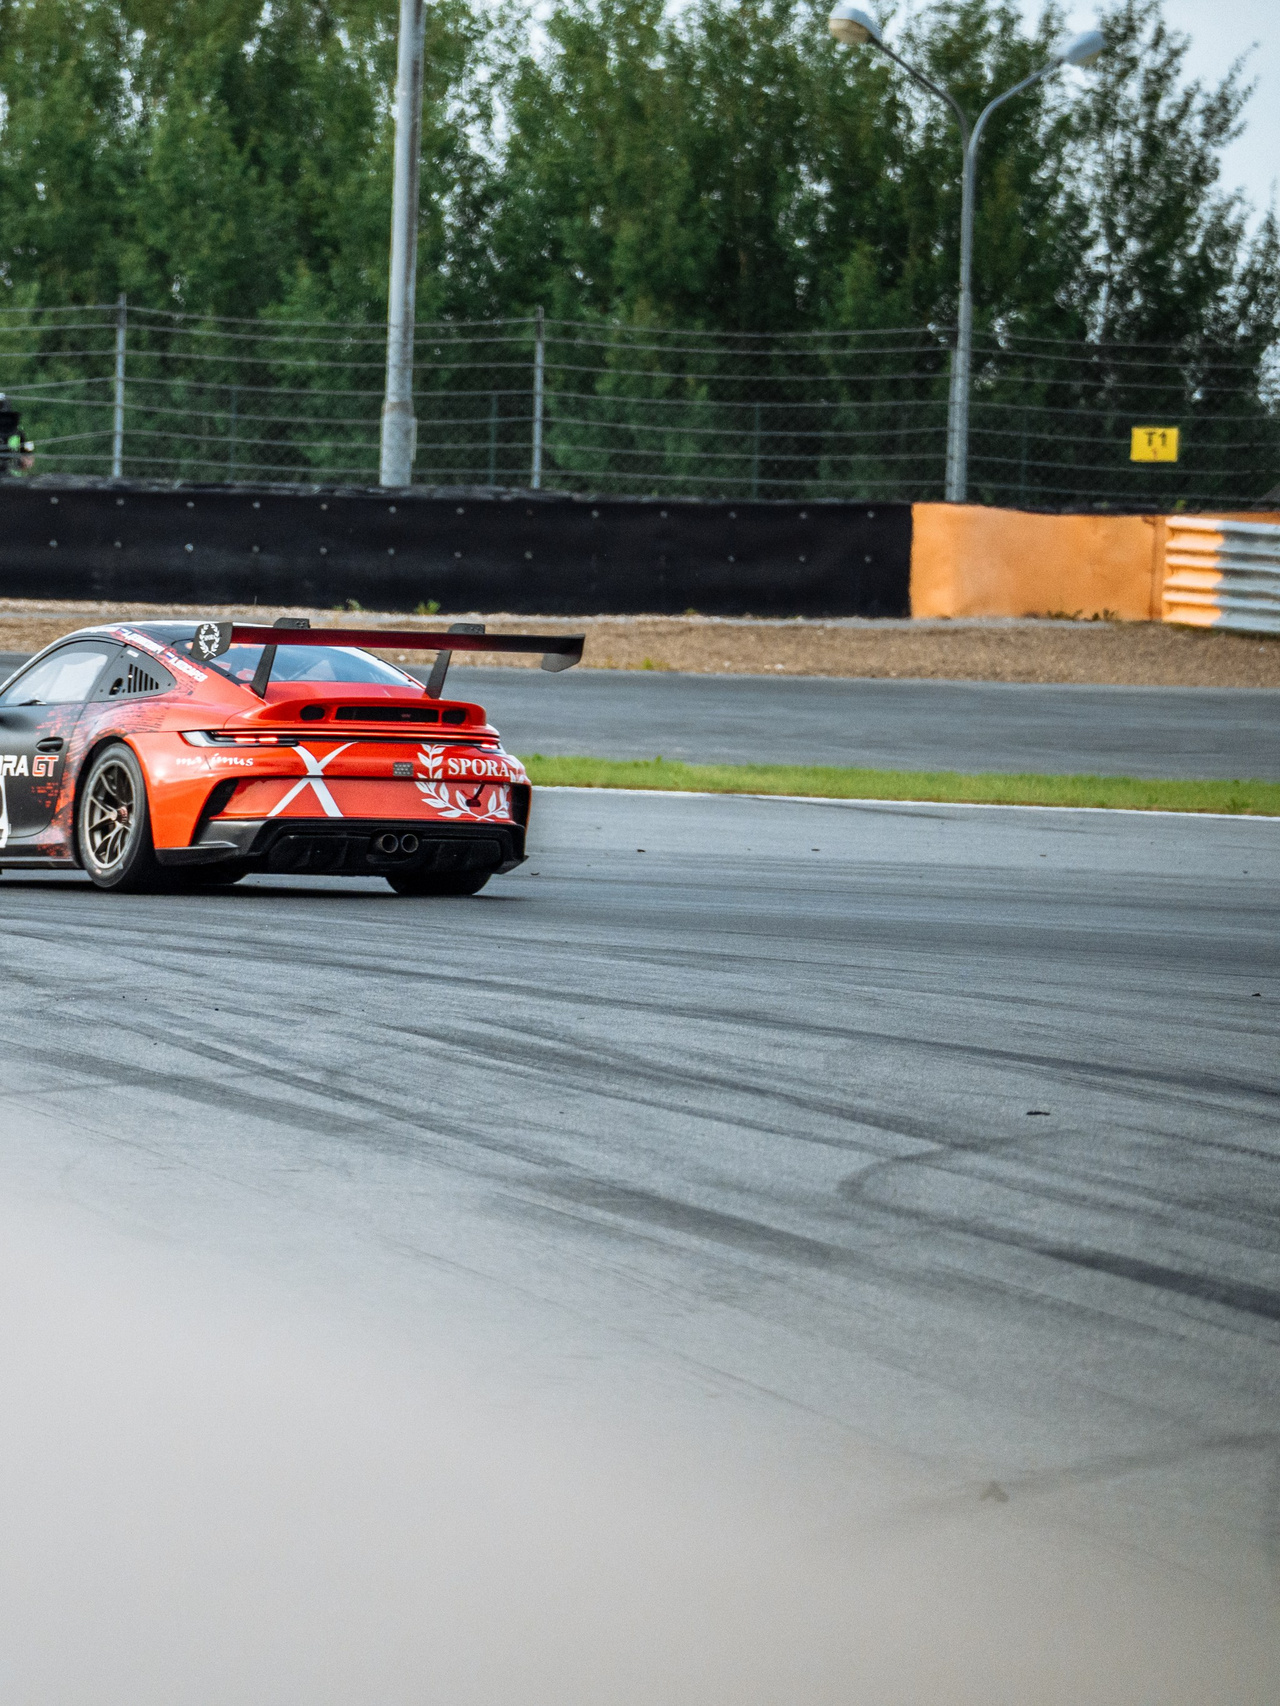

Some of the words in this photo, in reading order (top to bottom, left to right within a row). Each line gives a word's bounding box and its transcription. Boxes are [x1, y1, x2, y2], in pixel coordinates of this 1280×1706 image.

[1143, 431, 1168, 447] T1
[32, 755, 59, 777] GT
[447, 757, 510, 778] SPORA
